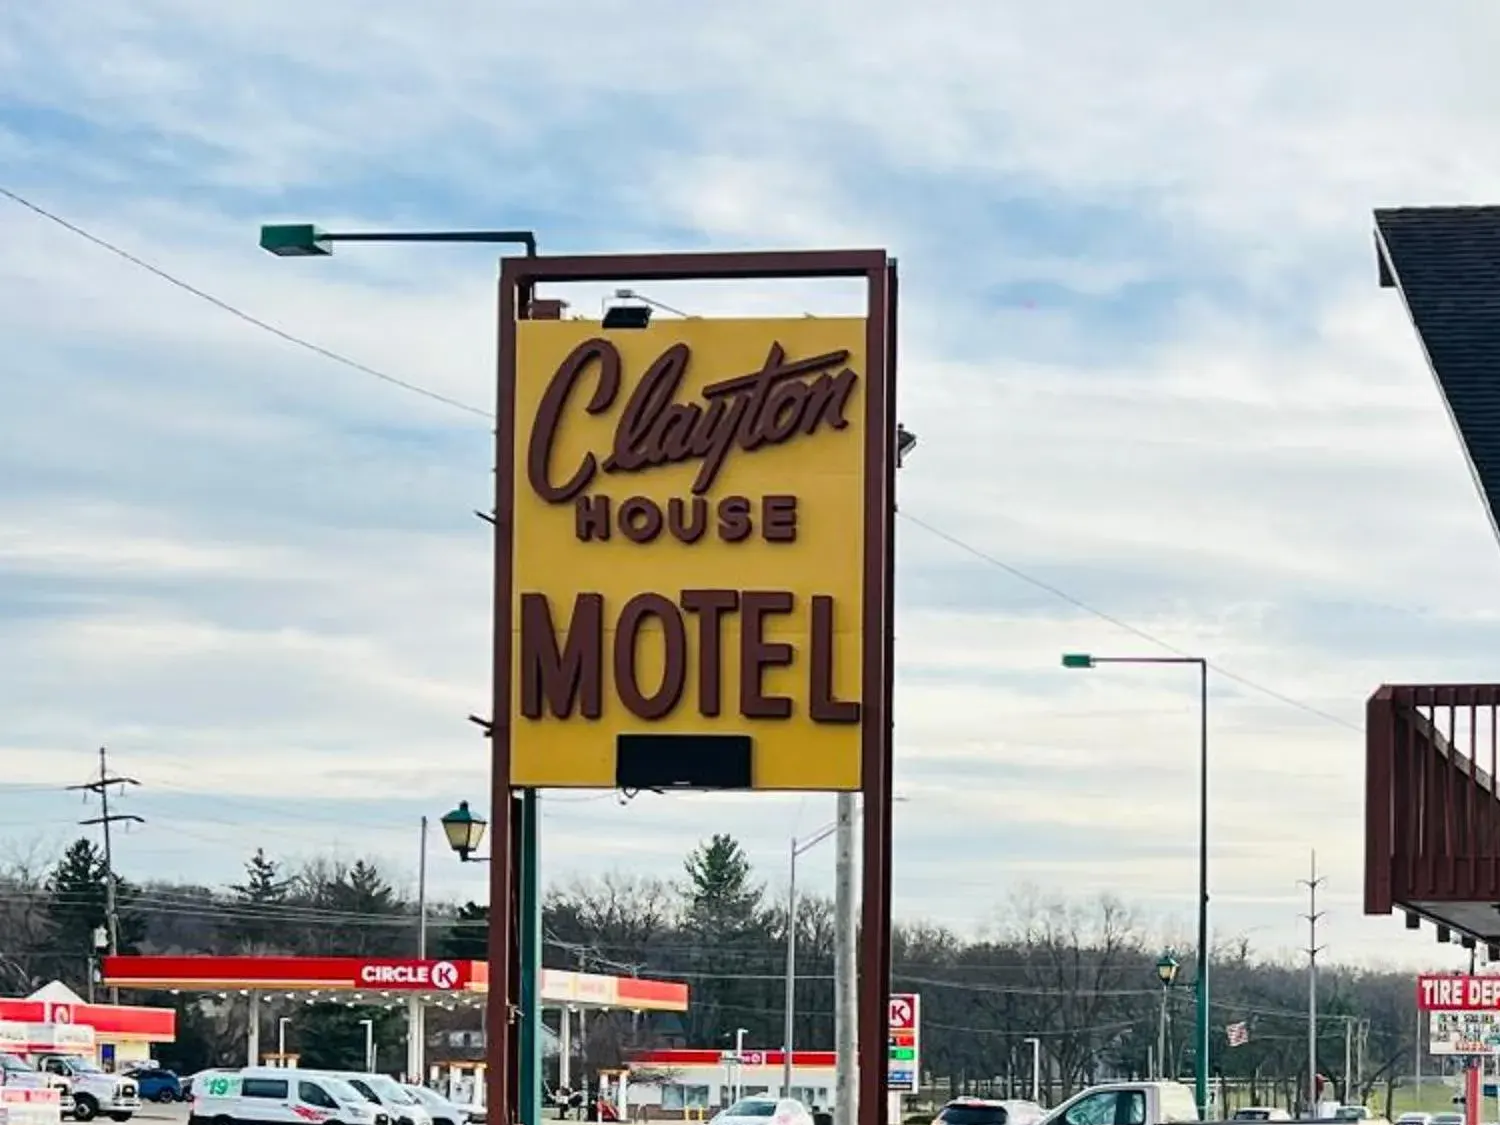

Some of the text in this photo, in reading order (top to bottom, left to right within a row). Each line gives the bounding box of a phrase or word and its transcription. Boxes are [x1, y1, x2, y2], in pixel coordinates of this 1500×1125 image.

[527, 337, 858, 505] Clayton
[576, 494, 797, 542] HOUSE
[520, 589, 861, 723] MOTEL
[361, 965, 429, 983] CIRCLE
[1421, 979, 1464, 1006] TIRE
